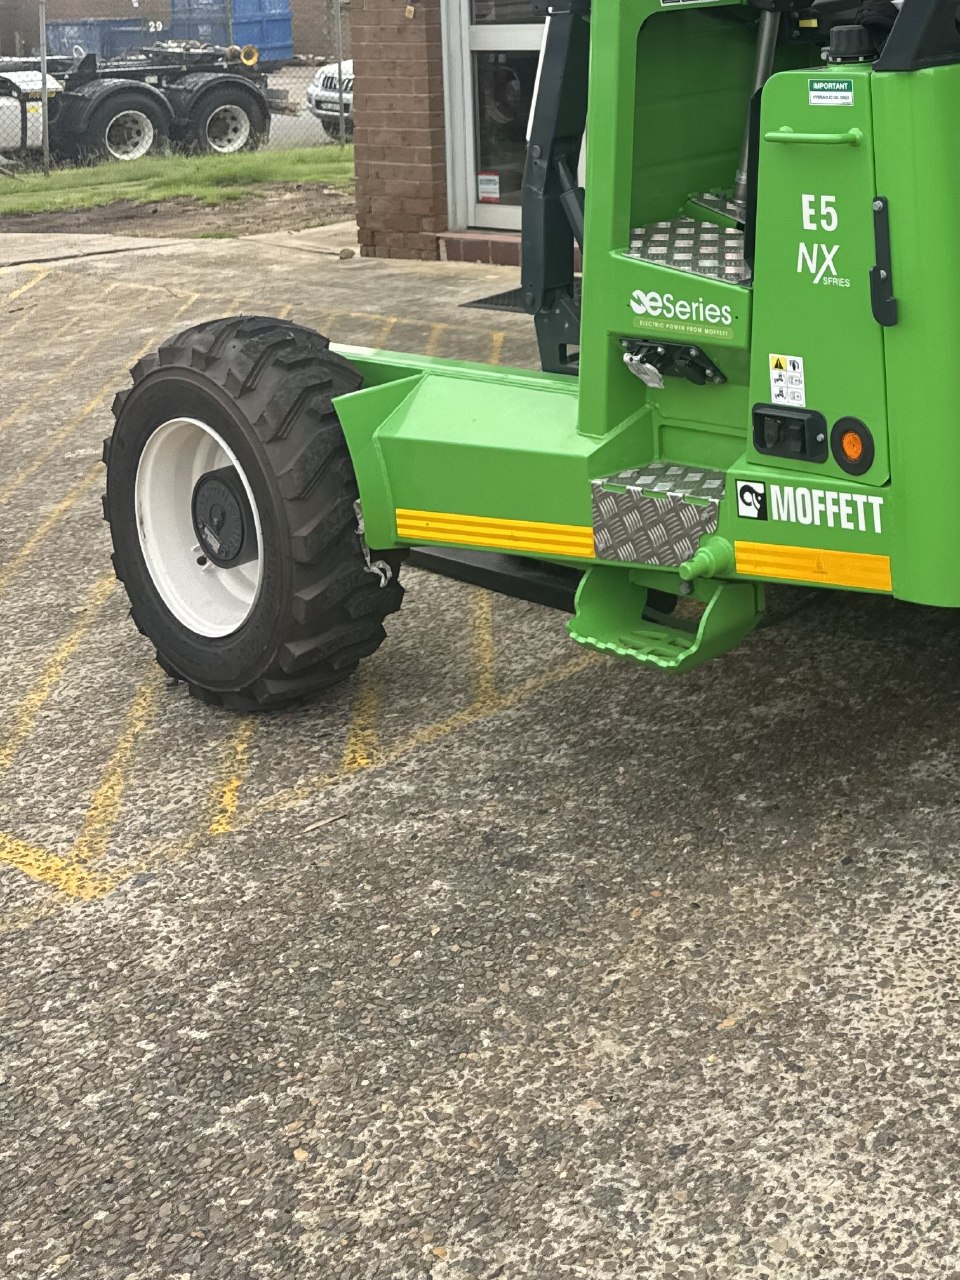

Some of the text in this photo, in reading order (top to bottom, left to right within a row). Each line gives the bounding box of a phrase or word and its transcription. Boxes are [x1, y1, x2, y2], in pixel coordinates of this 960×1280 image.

[813, 82, 848, 90] IMPORTANT
[801, 193, 838, 231] E5
[797, 242, 840, 284] NX
[640, 320, 728, 336] ELECTRIC POWER FROM MOFFETT
[769, 484, 884, 534] MOFFETT
